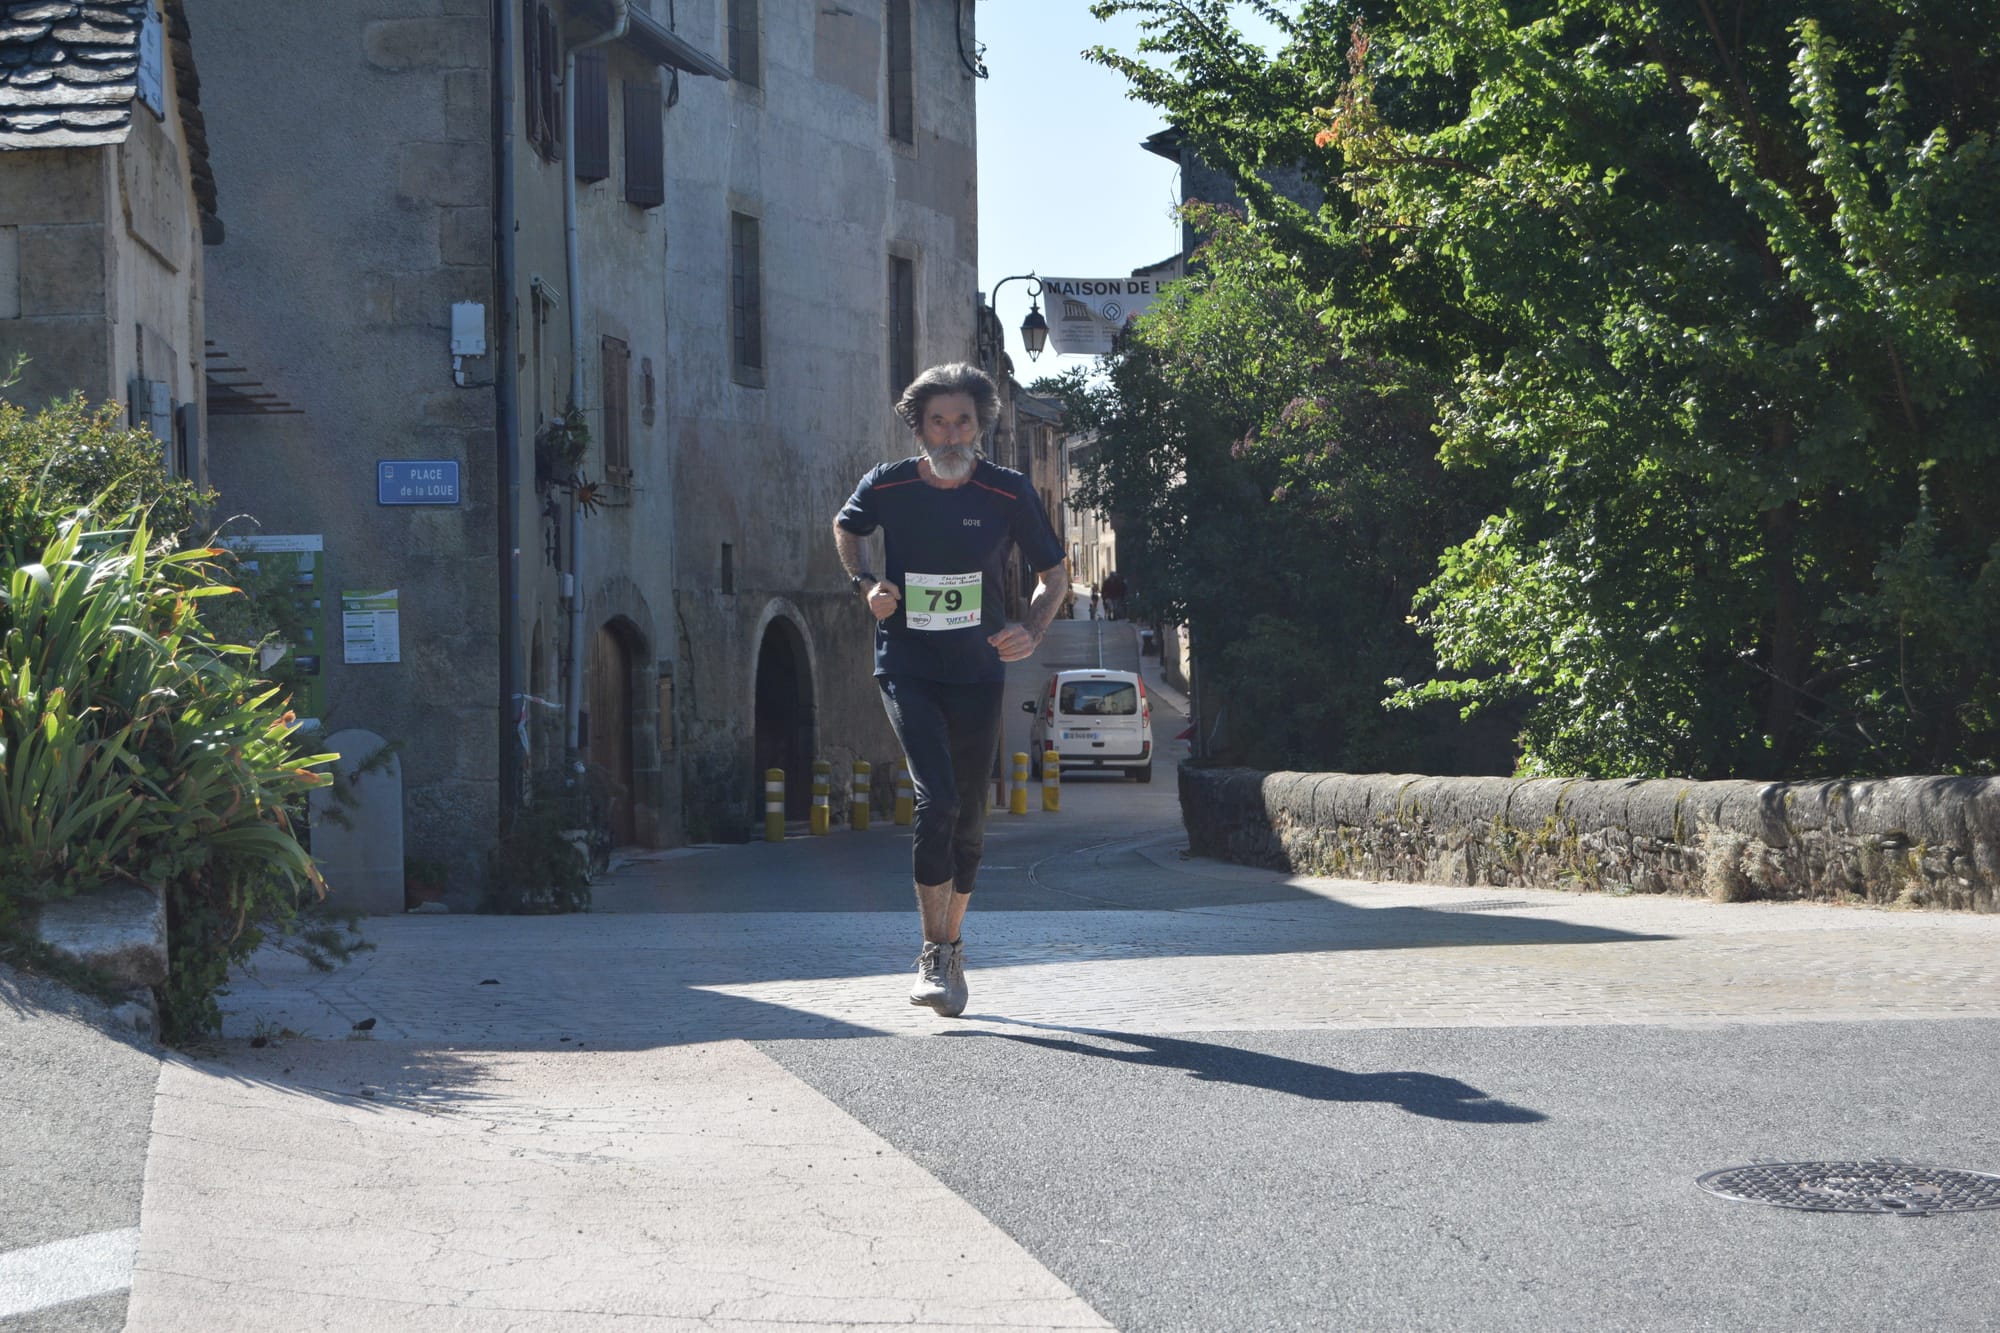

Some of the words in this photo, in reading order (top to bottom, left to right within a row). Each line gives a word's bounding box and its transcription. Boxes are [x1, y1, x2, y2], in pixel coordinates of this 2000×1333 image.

[1047, 281, 1121, 296] MAISON
[1127, 281, 1151, 295] DE
[410, 468, 443, 480] PLACE
[400, 484, 413, 496] de
[416, 484, 425, 496] la
[428, 484, 454, 496] LOUE
[925, 589, 963, 612] 79
